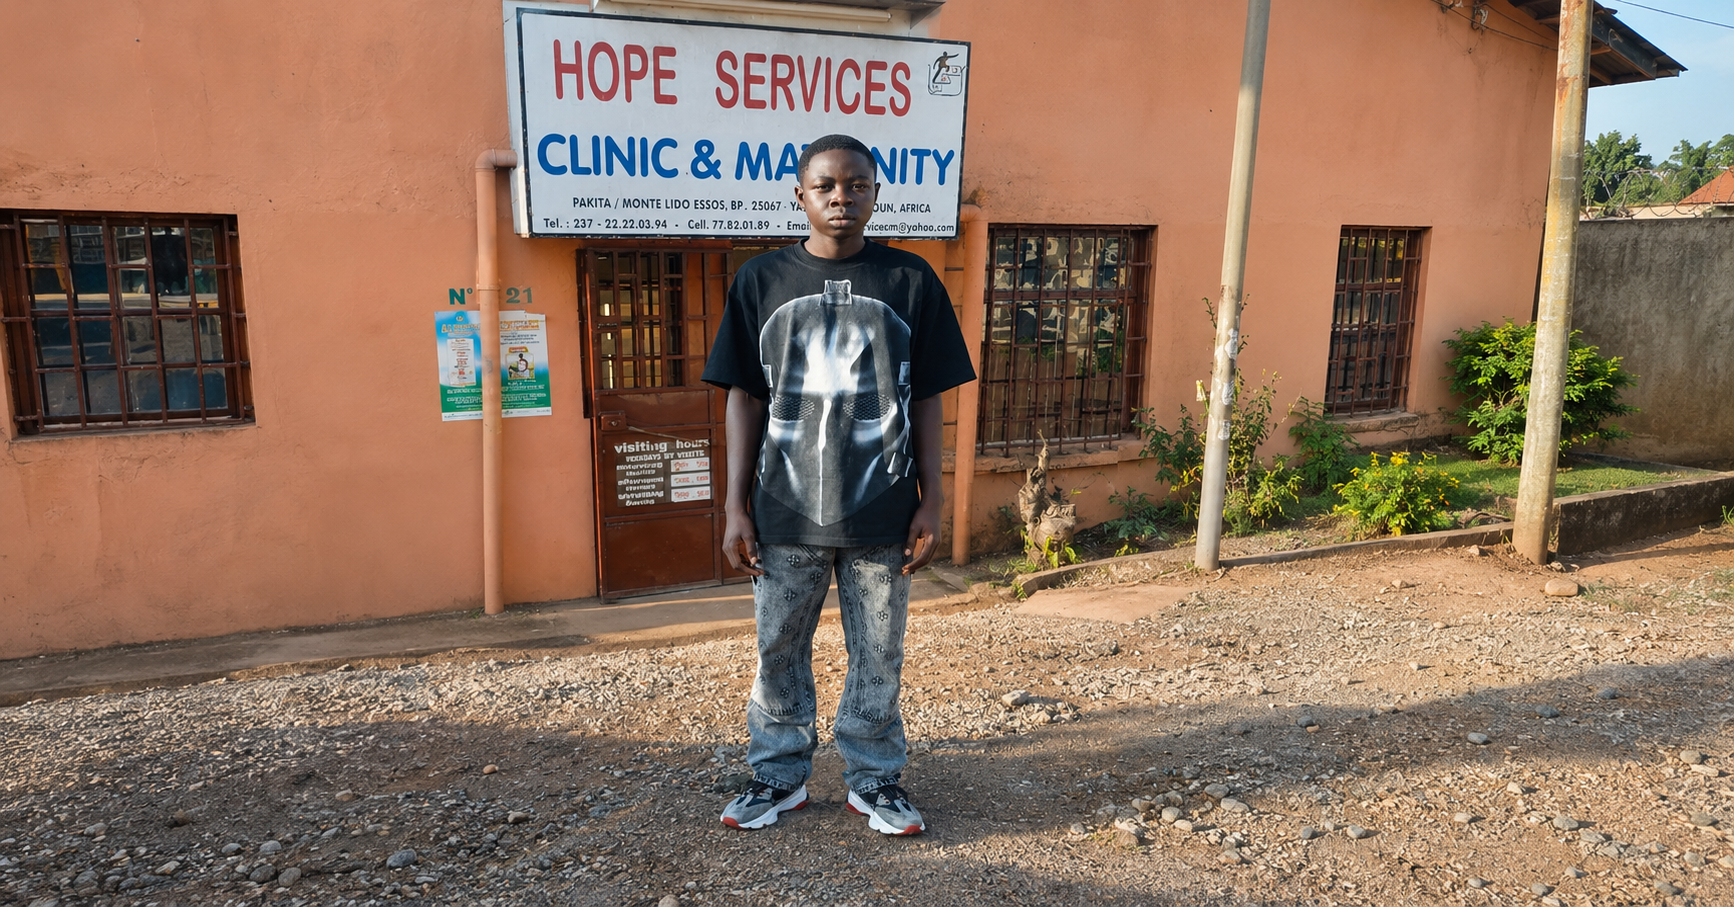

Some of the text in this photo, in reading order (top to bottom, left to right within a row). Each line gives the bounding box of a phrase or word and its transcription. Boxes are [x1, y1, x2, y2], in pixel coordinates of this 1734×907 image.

[553, 38, 911, 117] HOPE SERVICES
[536, 132, 955, 186] CLINIC & MANITY
[572, 196, 612, 209] PAKITA
[622, 197, 662, 210] MONTE
[665, 198, 691, 210] LIDO
[694, 199, 728, 212] ESSOS,
[751, 200, 782, 212] 25067
[900, 203, 931, 214] AFRICA
[543, 217, 563, 229] Tel.
[573, 218, 593, 229] 237
[604, 219, 668, 230] 22.22.03.94
[687, 219, 710, 230] Cell.
[712, 220, 770, 231] 77.82.01.89
[505, 286, 533, 304] 21
[614, 438, 711, 454] visiting hours
